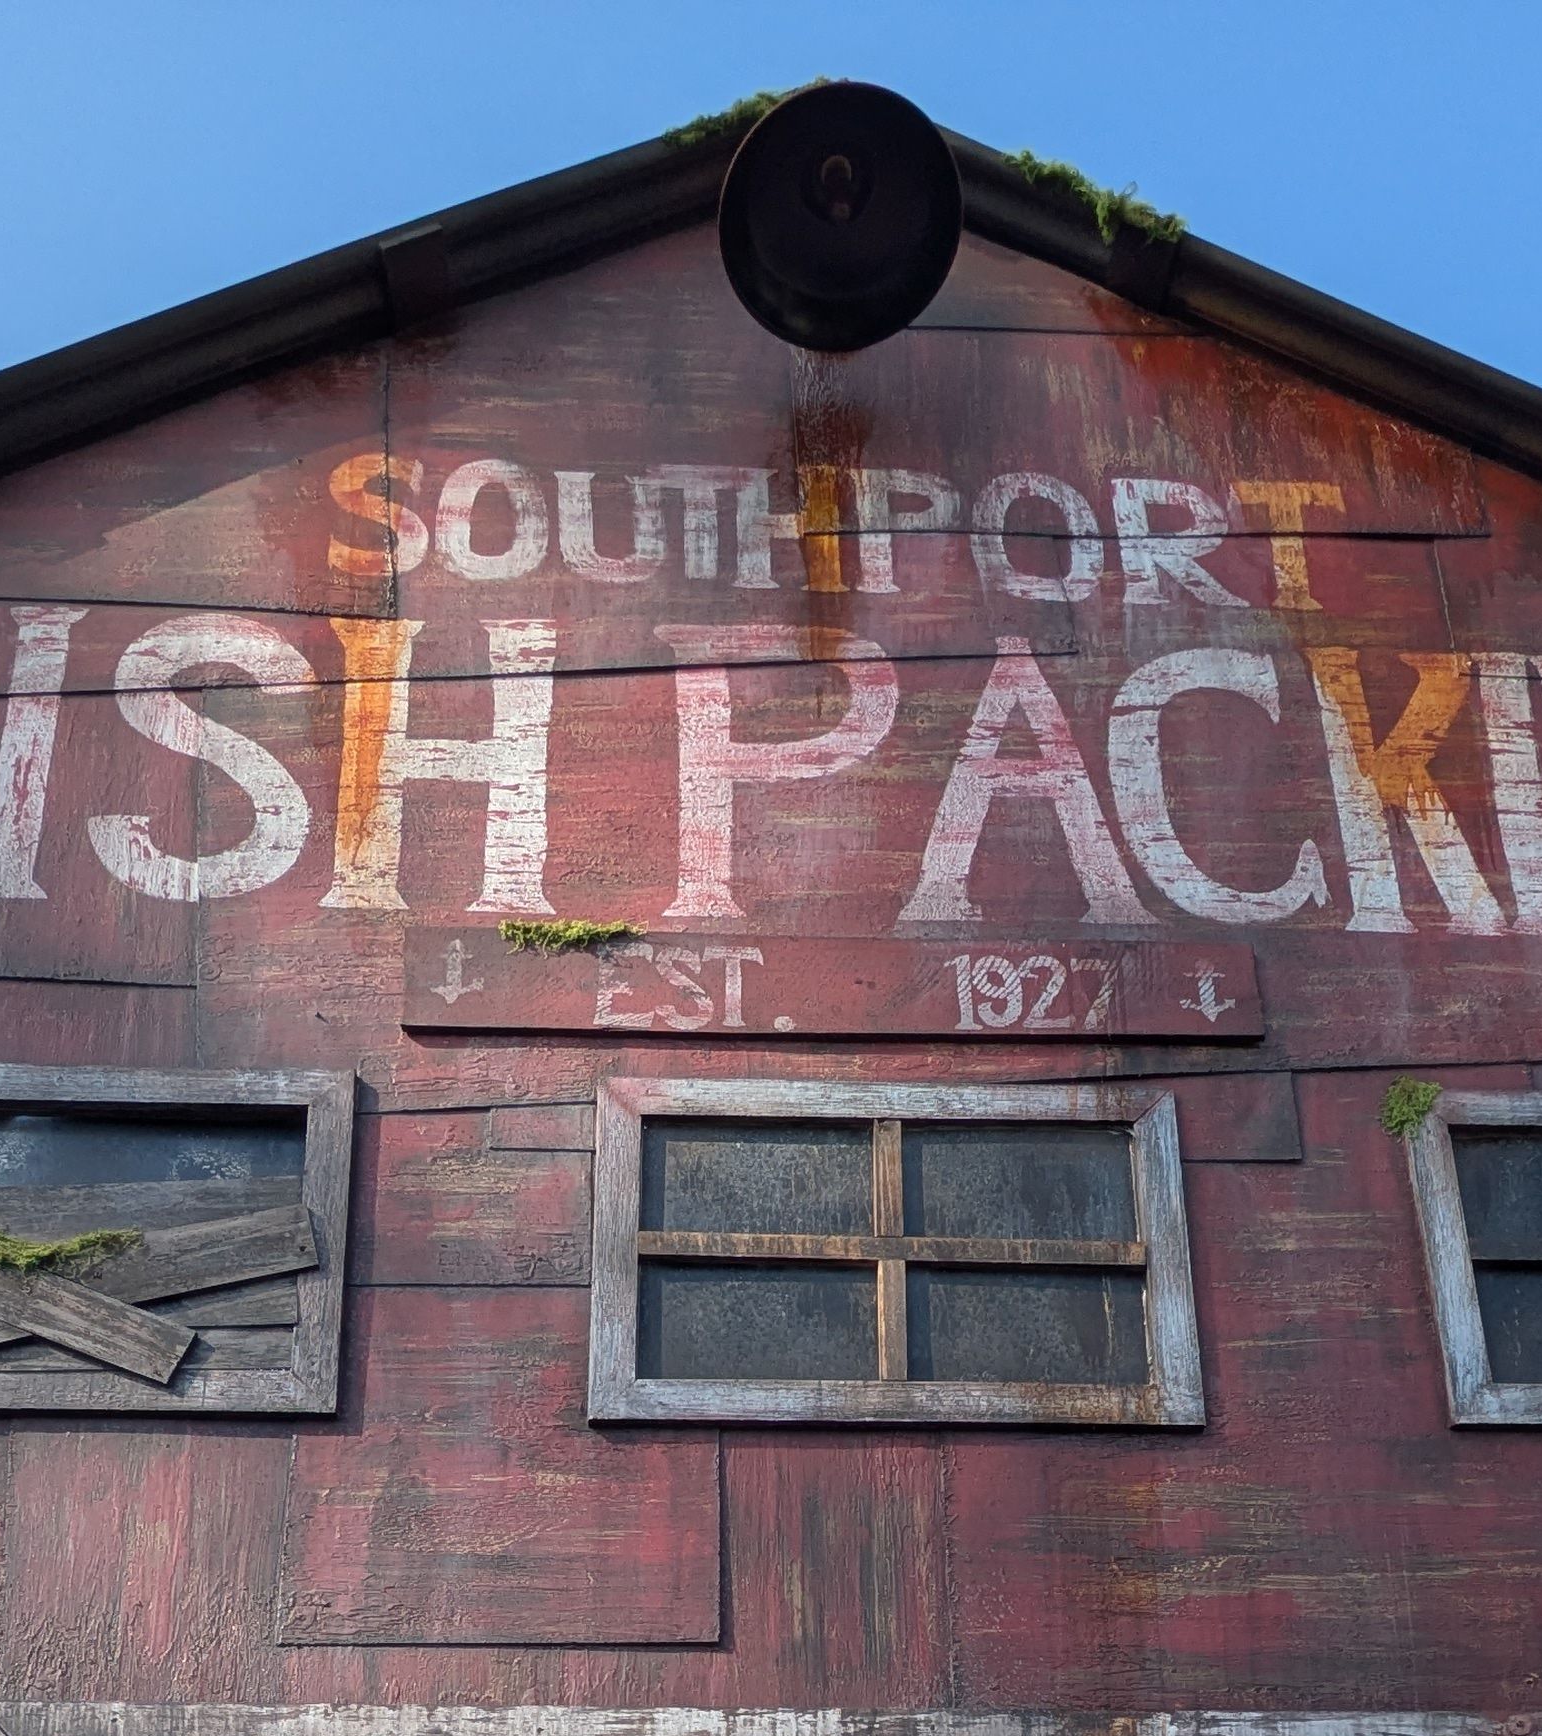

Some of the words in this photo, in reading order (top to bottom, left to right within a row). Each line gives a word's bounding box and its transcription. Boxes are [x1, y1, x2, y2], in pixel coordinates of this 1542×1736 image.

[327, 452, 1346, 612] SOUTHPORT
[592, 940, 799, 1032] EST.
[943, 952, 1122, 1031] 1927
